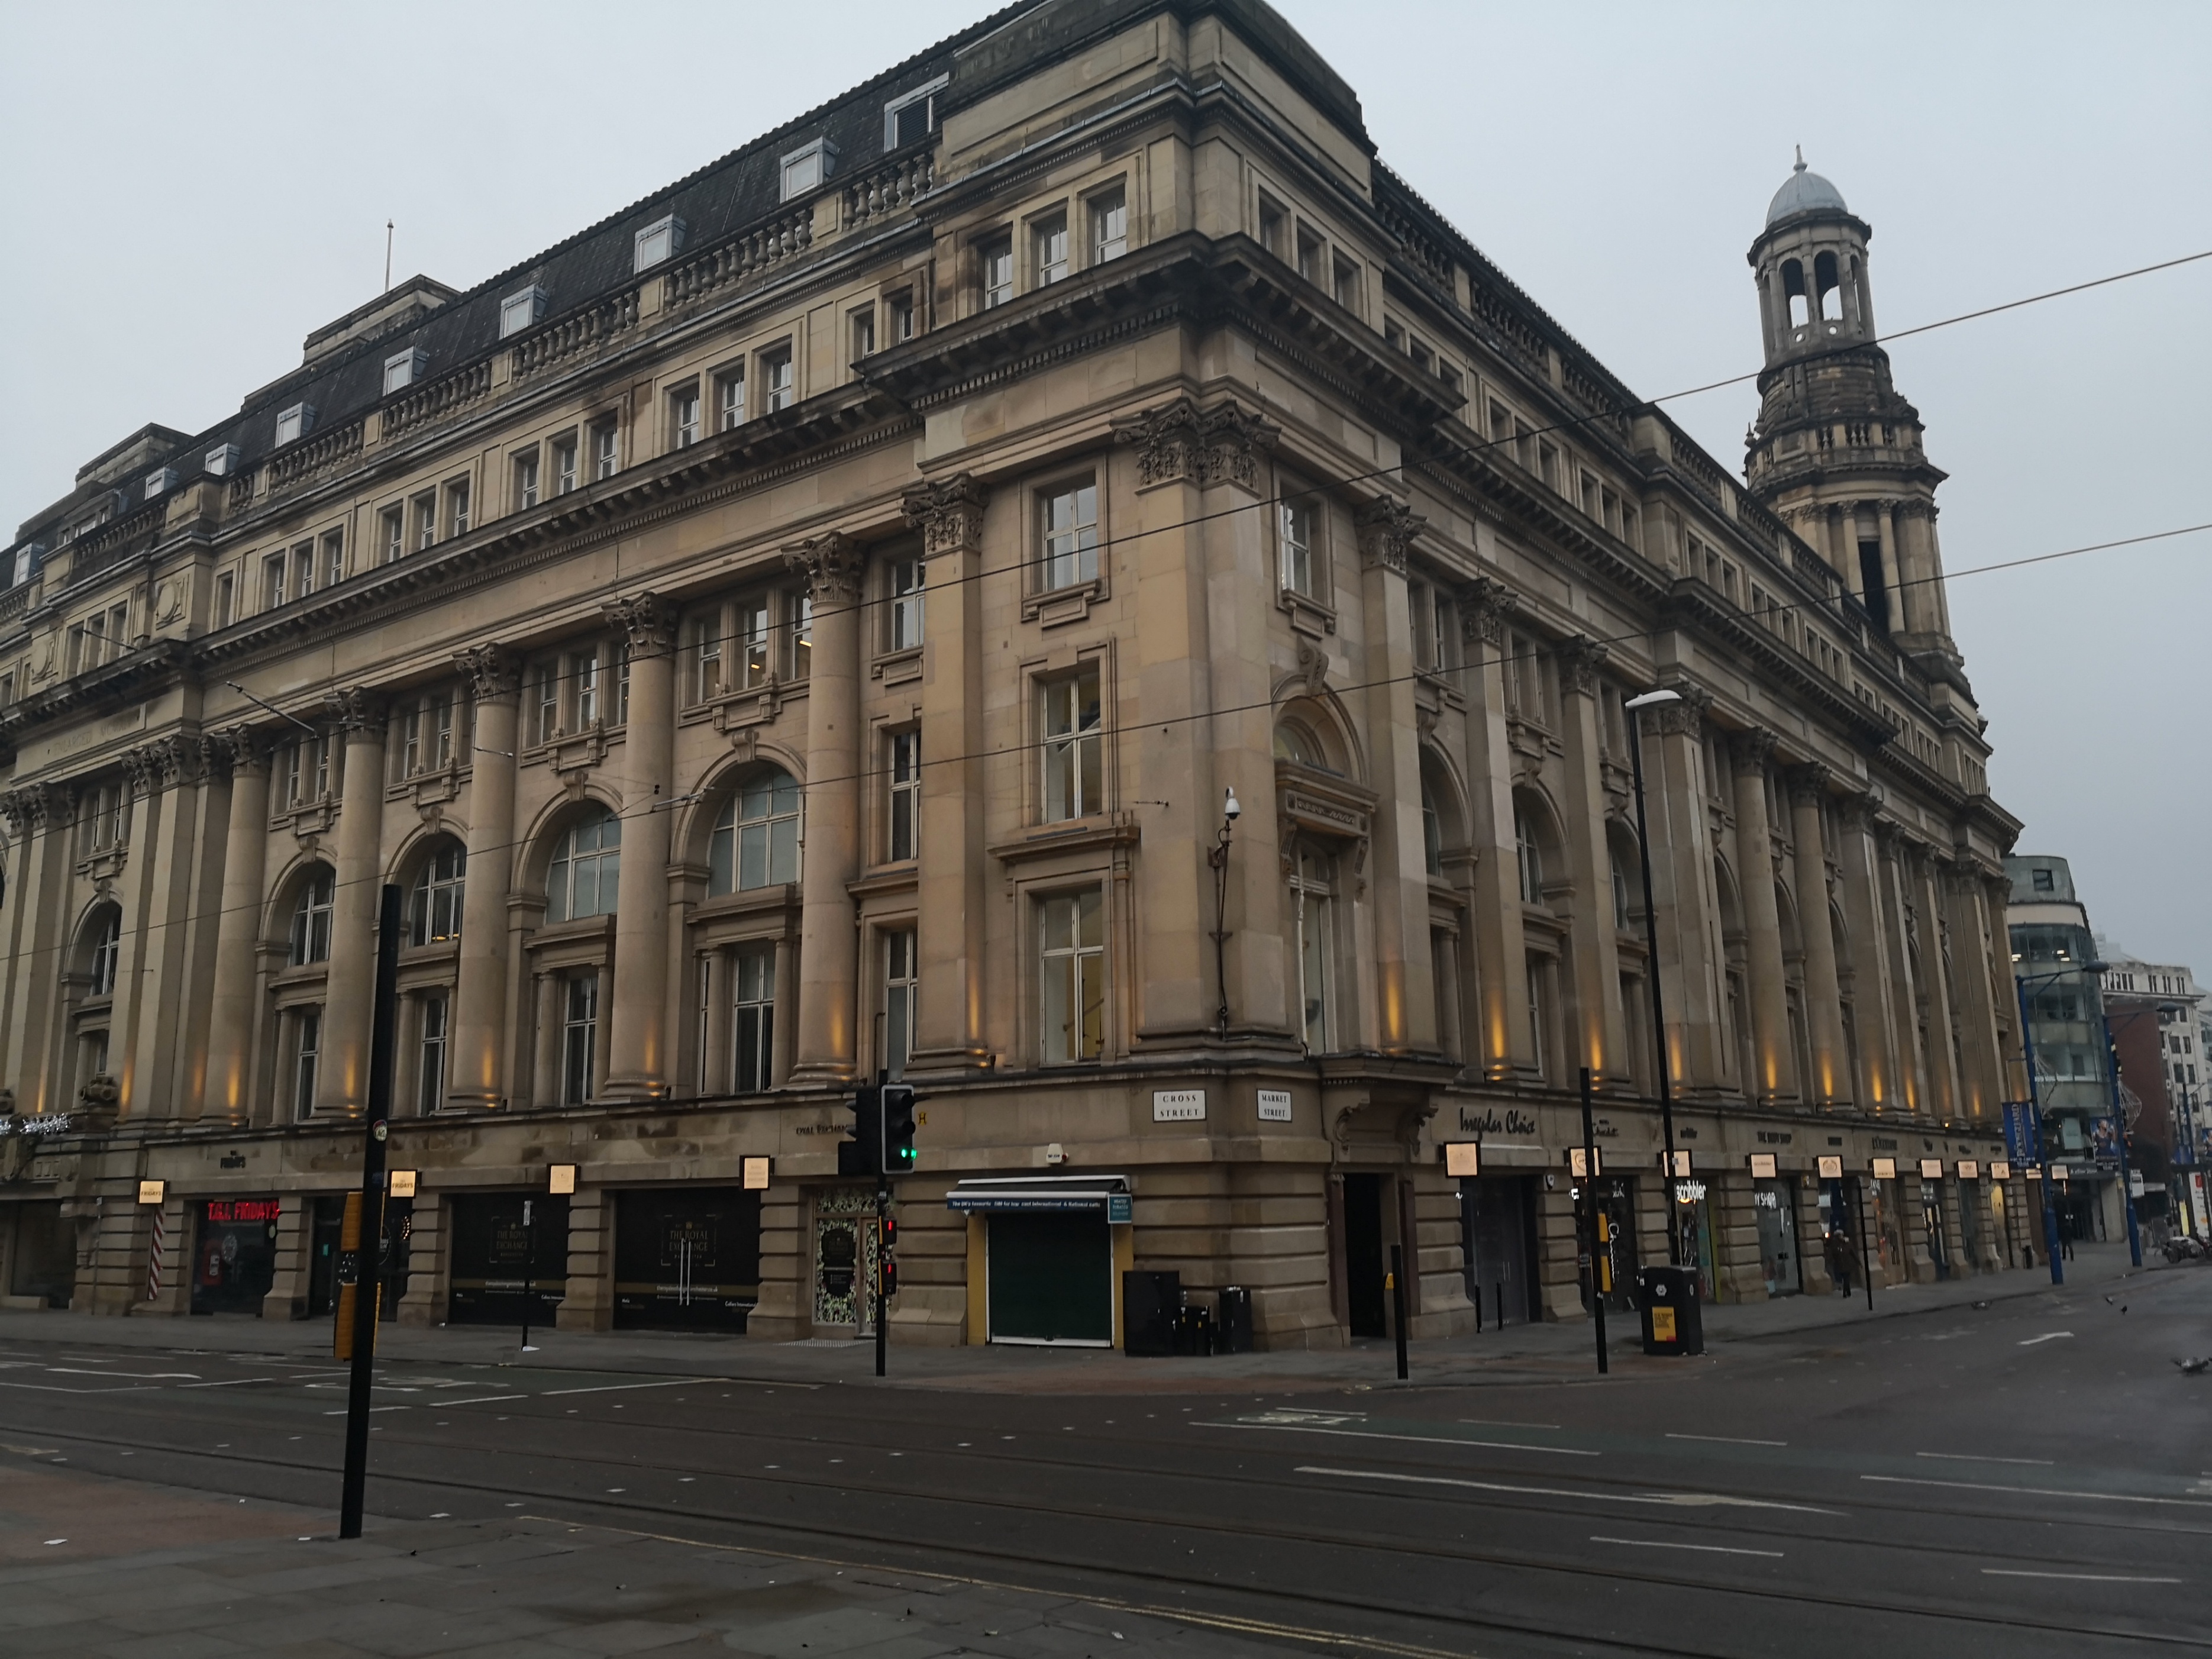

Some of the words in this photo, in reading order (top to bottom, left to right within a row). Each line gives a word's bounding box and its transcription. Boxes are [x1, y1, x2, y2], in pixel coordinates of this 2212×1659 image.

[1262, 1094, 1286, 1103] MARKET
[1160, 1109, 1199, 1117] STREET
[1264, 1108, 1285, 1117] STREET
[1506, 1109, 1535, 1134] Choice
[1676, 1180, 1706, 1200] scribbler
[1761, 1192, 1777, 1209] SHOP
[234, 1200, 280, 1220] FRIDAYS
[670, 1231, 682, 1240] THE
[685, 1231, 708, 1240] ROYAL
